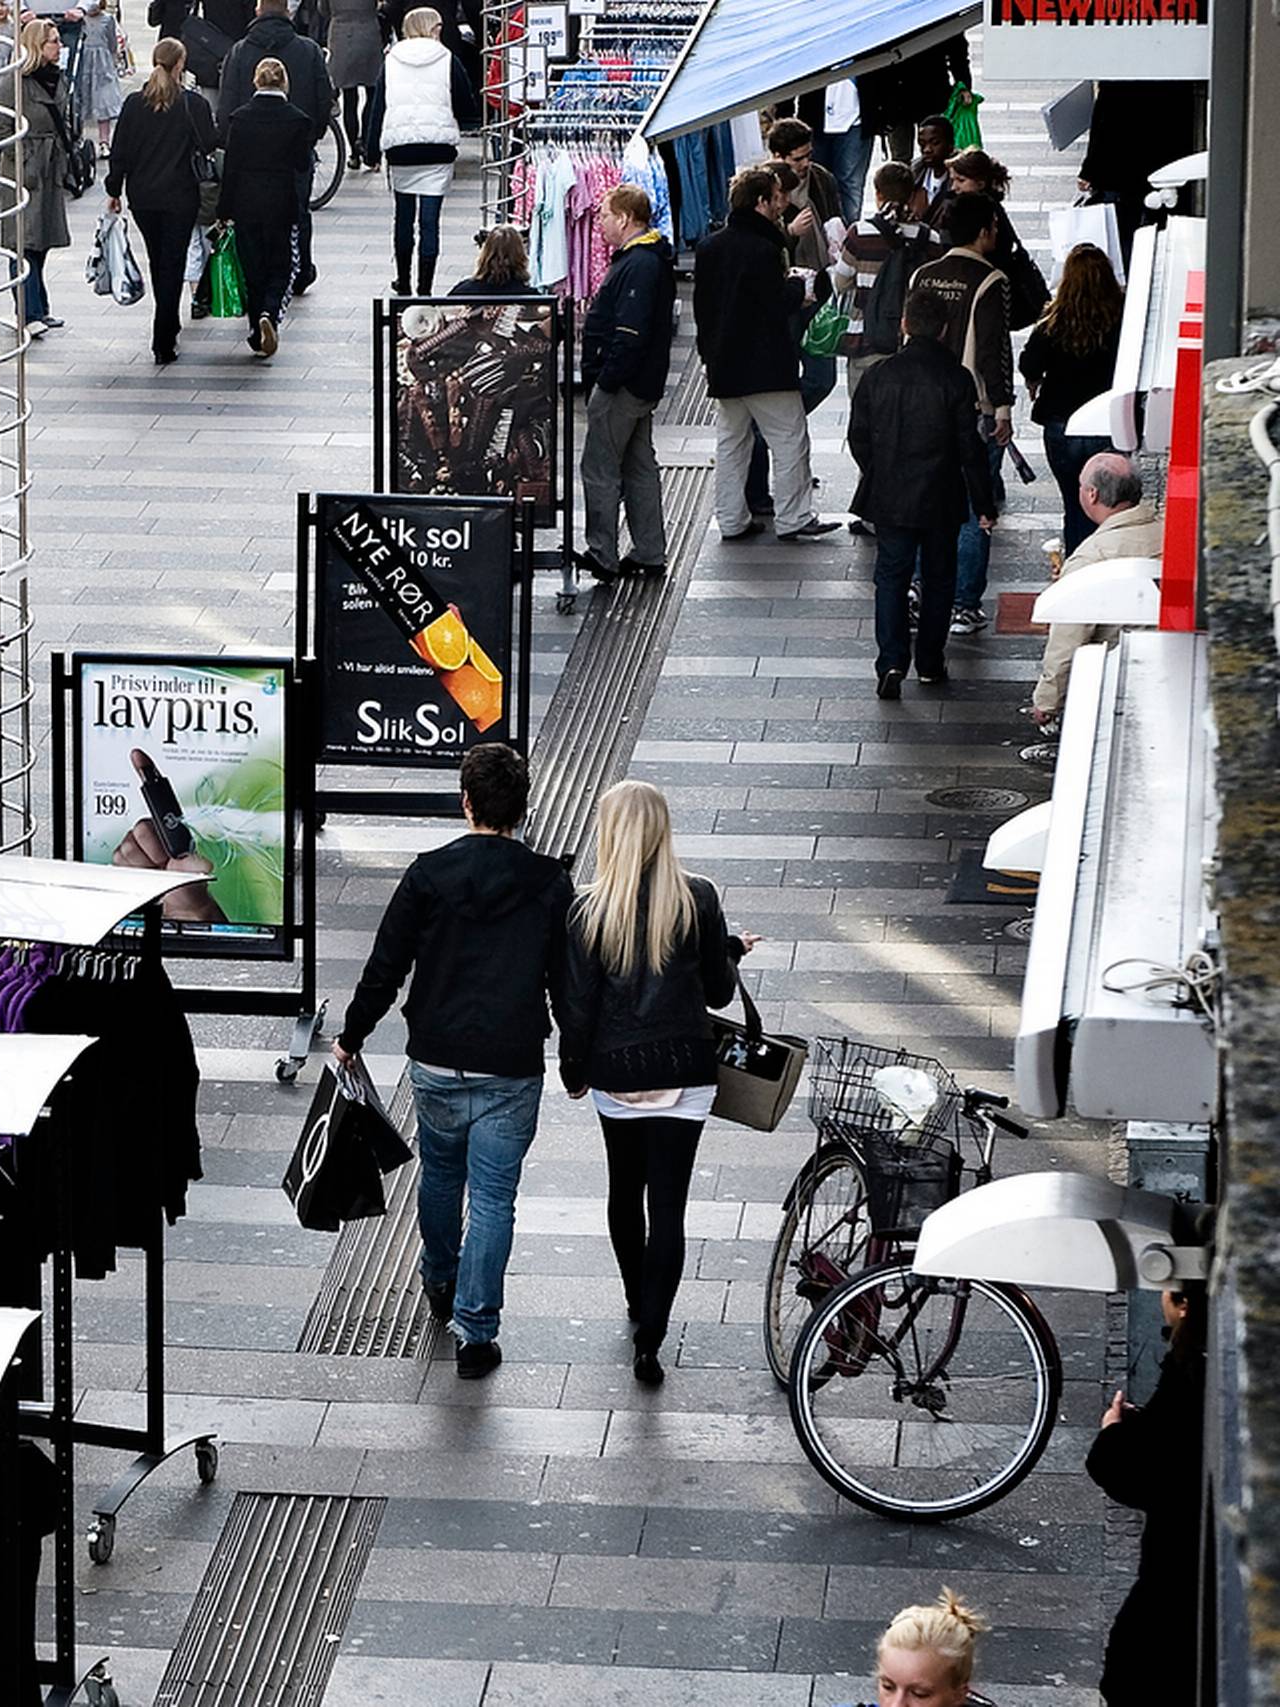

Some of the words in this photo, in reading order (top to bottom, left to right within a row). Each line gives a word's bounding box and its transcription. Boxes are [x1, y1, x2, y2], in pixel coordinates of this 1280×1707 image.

[426, 520, 470, 550] sol
[342, 511, 391, 566] NYE
[385, 566, 434, 622] RØR
[410, 550, 428, 567] 10
[432, 551, 453, 568] kr.
[111, 675, 195, 695] Prisvinder
[198, 675, 215, 695] til
[93, 680, 259, 744] lavpris.
[357, 700, 464, 747] SlikSol
